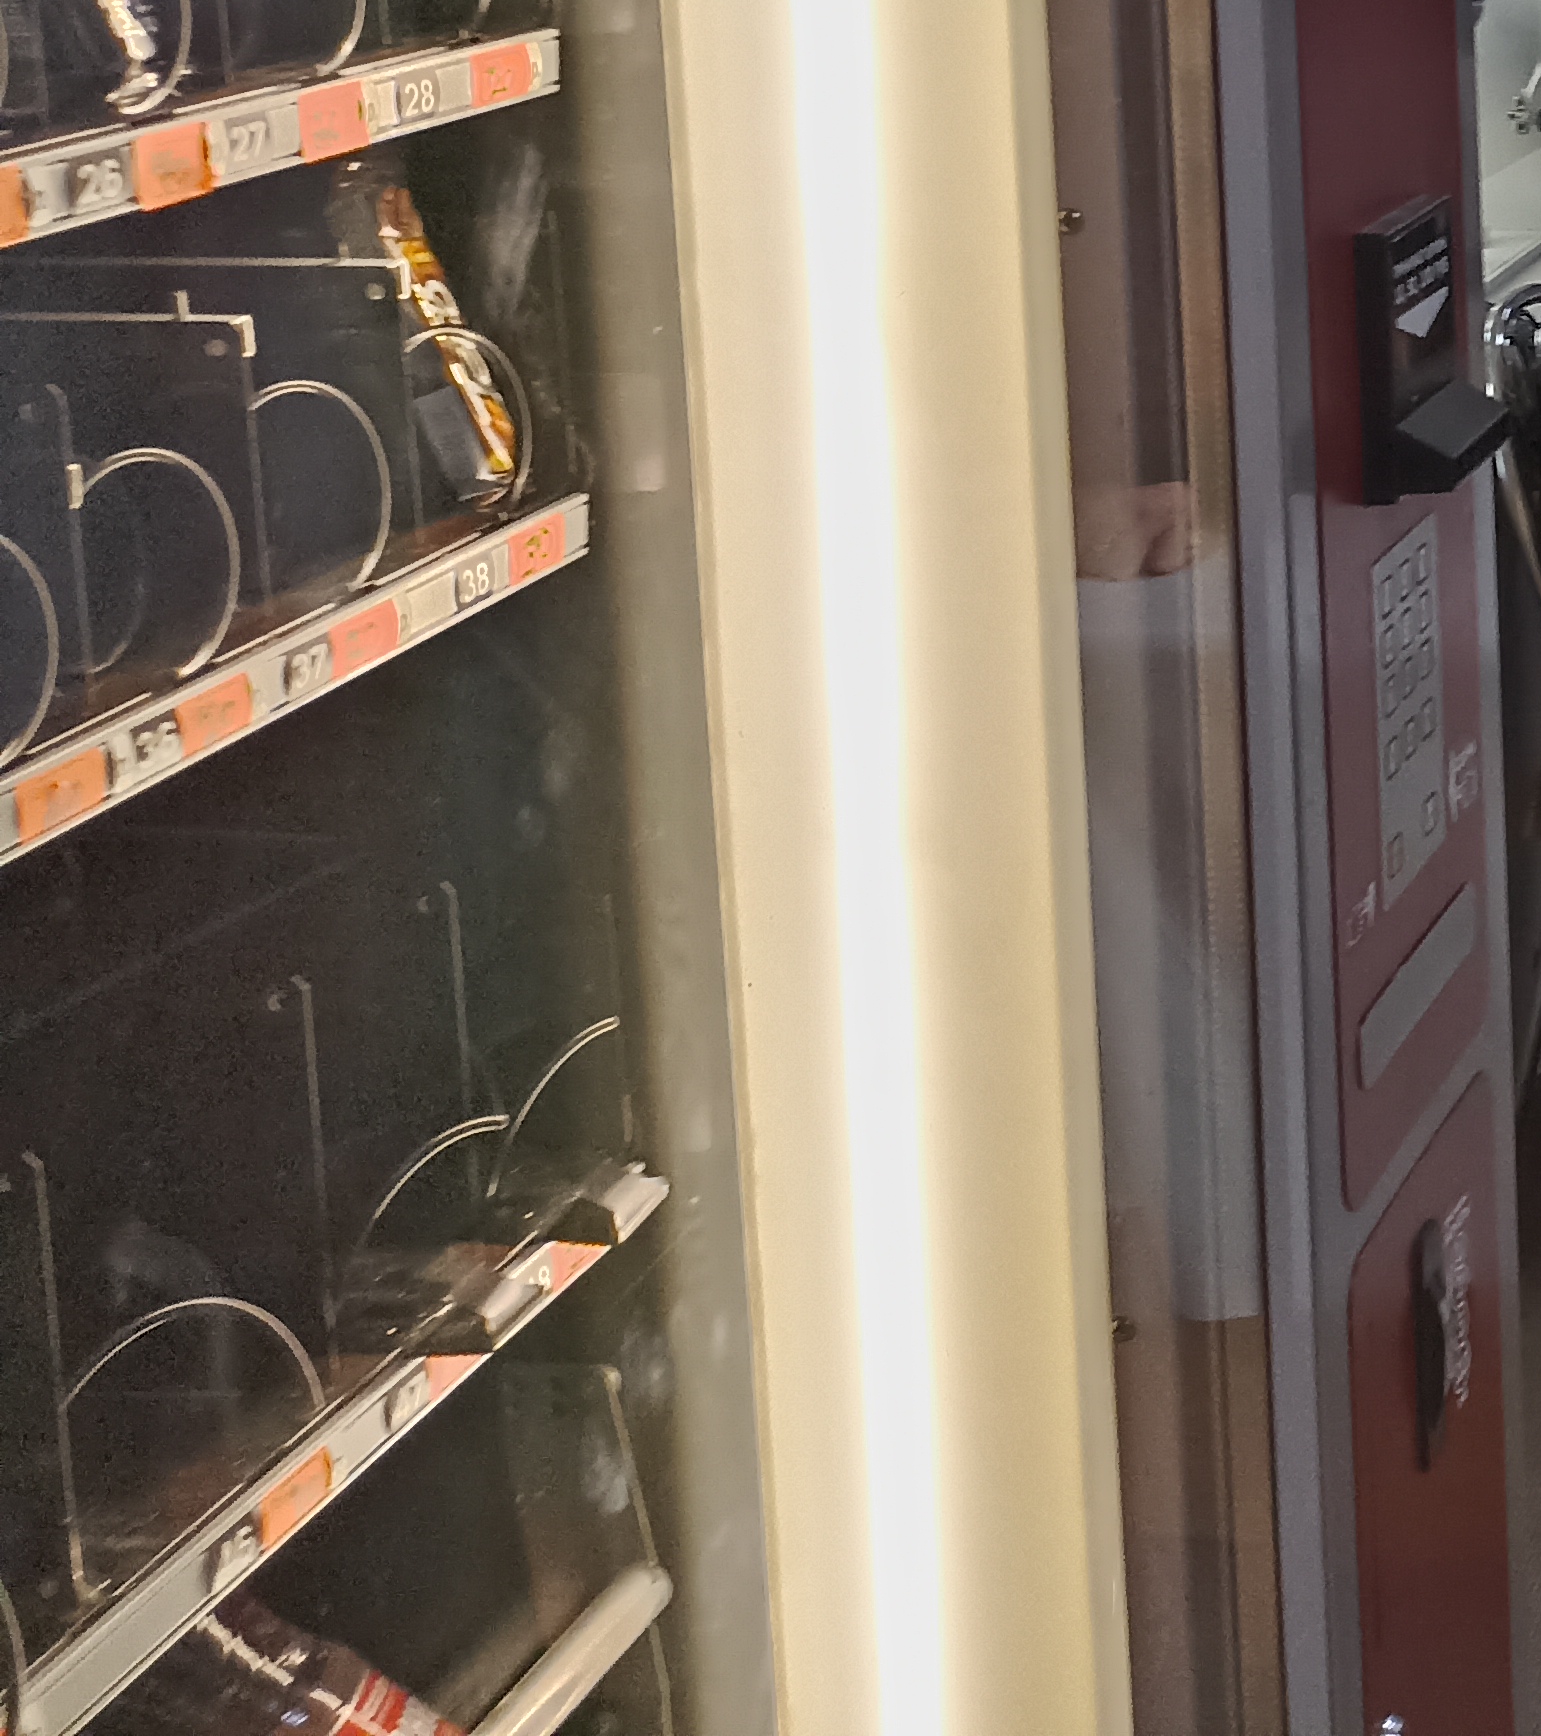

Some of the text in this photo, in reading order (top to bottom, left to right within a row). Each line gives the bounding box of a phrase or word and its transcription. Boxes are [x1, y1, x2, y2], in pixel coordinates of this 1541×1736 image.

[229, 121, 268, 162] 27
[404, 79, 435, 115] 28
[291, 643, 328, 689] 37
[460, 562, 490, 603] 38
